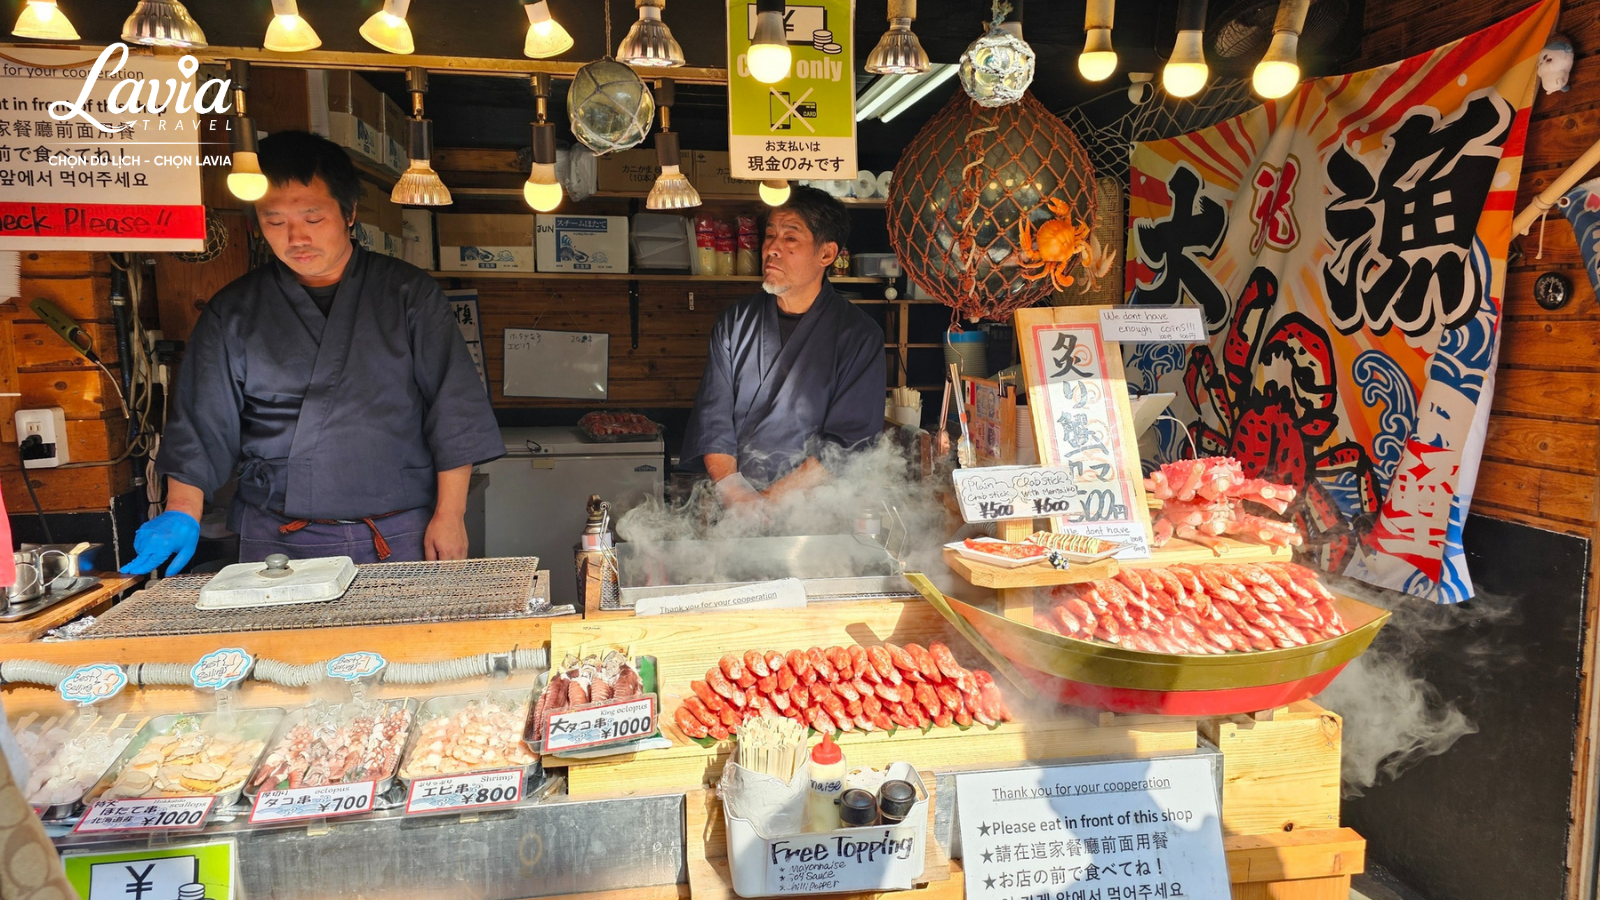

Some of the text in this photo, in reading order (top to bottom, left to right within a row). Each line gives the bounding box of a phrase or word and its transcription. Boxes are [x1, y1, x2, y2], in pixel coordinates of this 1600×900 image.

[3, 64, 22, 76] for
[26, 67, 58, 78] your
[796, 57, 843, 82] only
[13, 97, 27, 111] in
[765, 140, 821, 152] お支払いは
[748, 156, 844, 172] 現金のみです
[60, 170, 149, 188] 먹어주세요
[0, 206, 52, 234] eck
[536, 224, 554, 234] JUN
[1103, 311, 1169, 320] We dont have
[1119, 325, 1152, 336] enough
[967, 480, 994, 492] Plain
[979, 497, 1069, 519] ¥500 ¥600
[1106, 526, 1130, 534] have
[660, 605, 684, 614] Thank
[701, 601, 712, 610] for
[714, 598, 731, 609] your
[733, 591, 777, 606] cooperation
[201, 657, 221, 671] Best
[73, 673, 95, 683] Best
[616, 703, 648, 714] octopus
[550, 718, 607, 735] 大タコ串
[601, 716, 651, 739] ¥1000
[480, 774, 514, 783] Shrimp
[315, 786, 350, 795] octopus
[422, 783, 469, 798] エビ串
[992, 776, 1171, 800] Thank you for your cooperation
[264, 795, 311, 807] タコ串
[461, 786, 518, 805] ¥800
[100, 805, 158, 816] ほたて串
[317, 795, 368, 812] ¥700
[142, 810, 204, 826] ¥1000
[992, 807, 1193, 835] Please eat in front of this shop
[770, 830, 913, 865] Free Topping
[995, 831, 1169, 863] 請在這家餐廳前面用餐
[806, 870, 835, 880] Sauce
